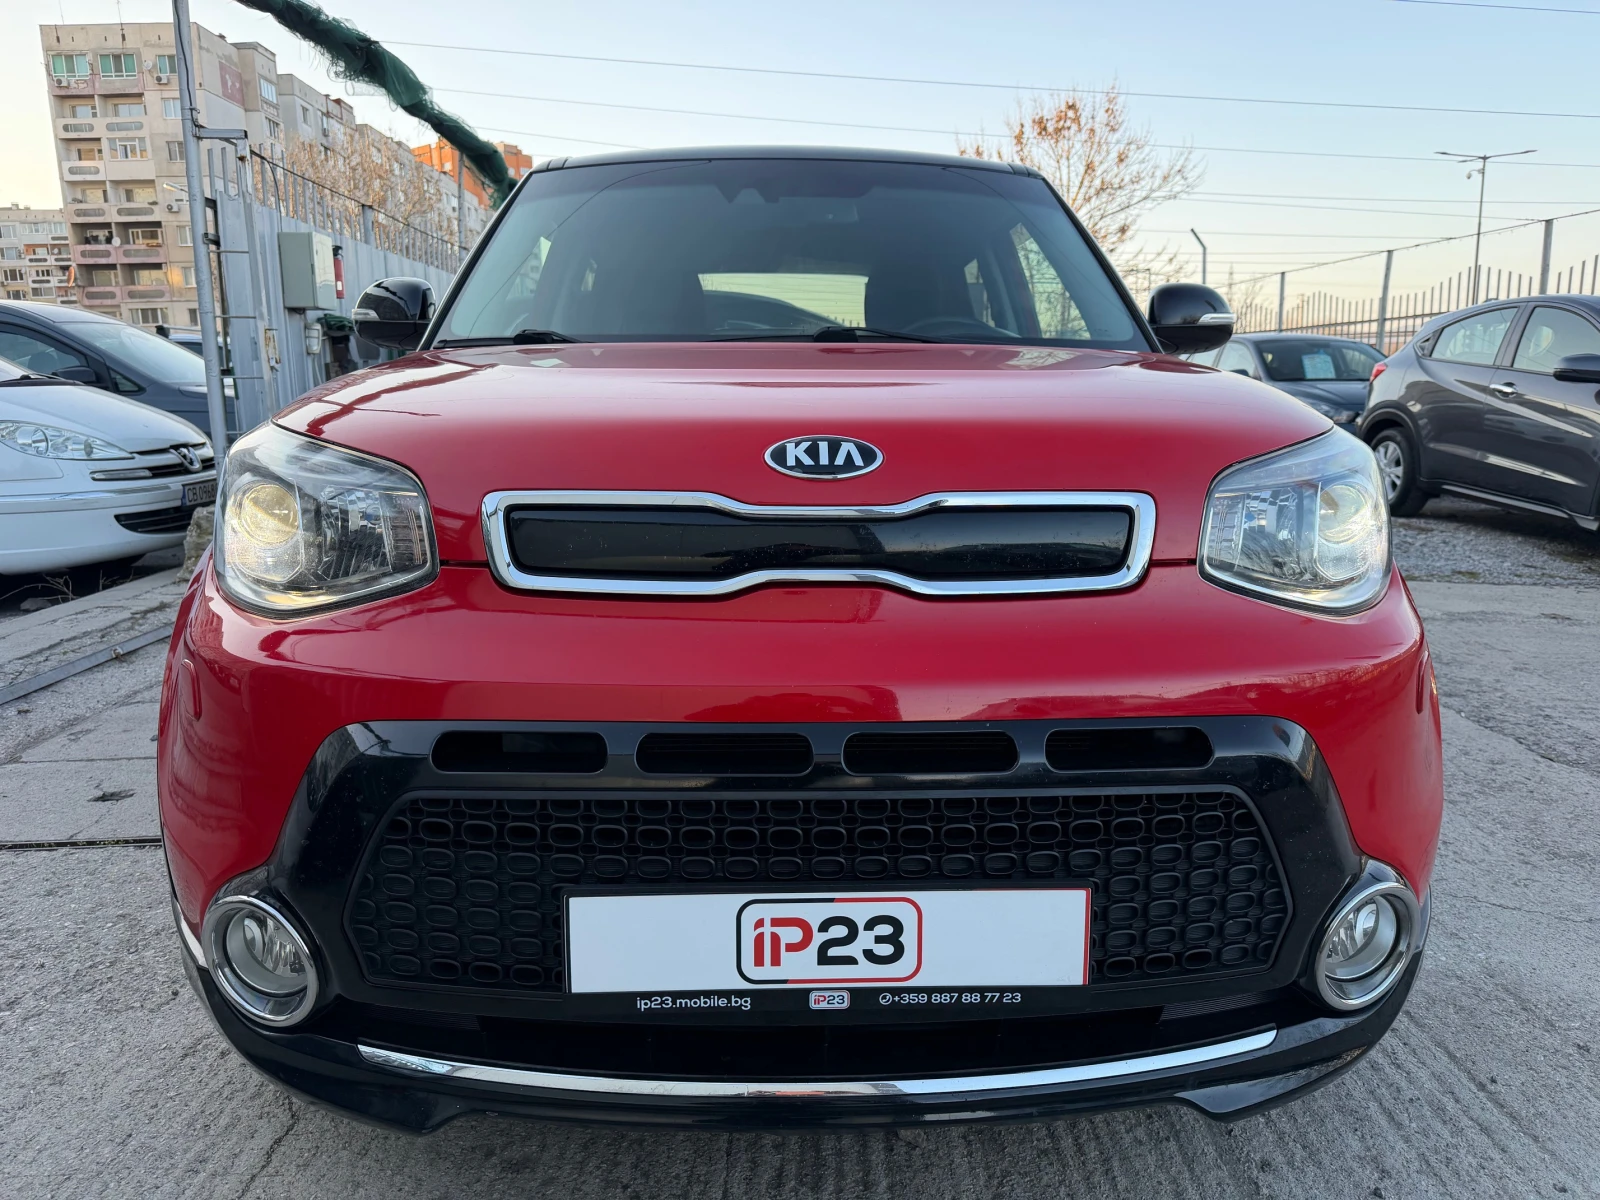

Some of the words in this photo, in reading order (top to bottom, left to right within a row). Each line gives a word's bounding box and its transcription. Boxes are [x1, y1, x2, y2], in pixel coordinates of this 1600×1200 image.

[785, 441, 864, 466] KIA
[636, 996, 751, 1011] ip23.mobile.bg
[893, 993, 928, 1004] +359
[931, 993, 958, 1004] 887
[961, 993, 981, 1003] 88
[984, 993, 1000, 1003] 77
[1002, 992, 1022, 1003] 23
